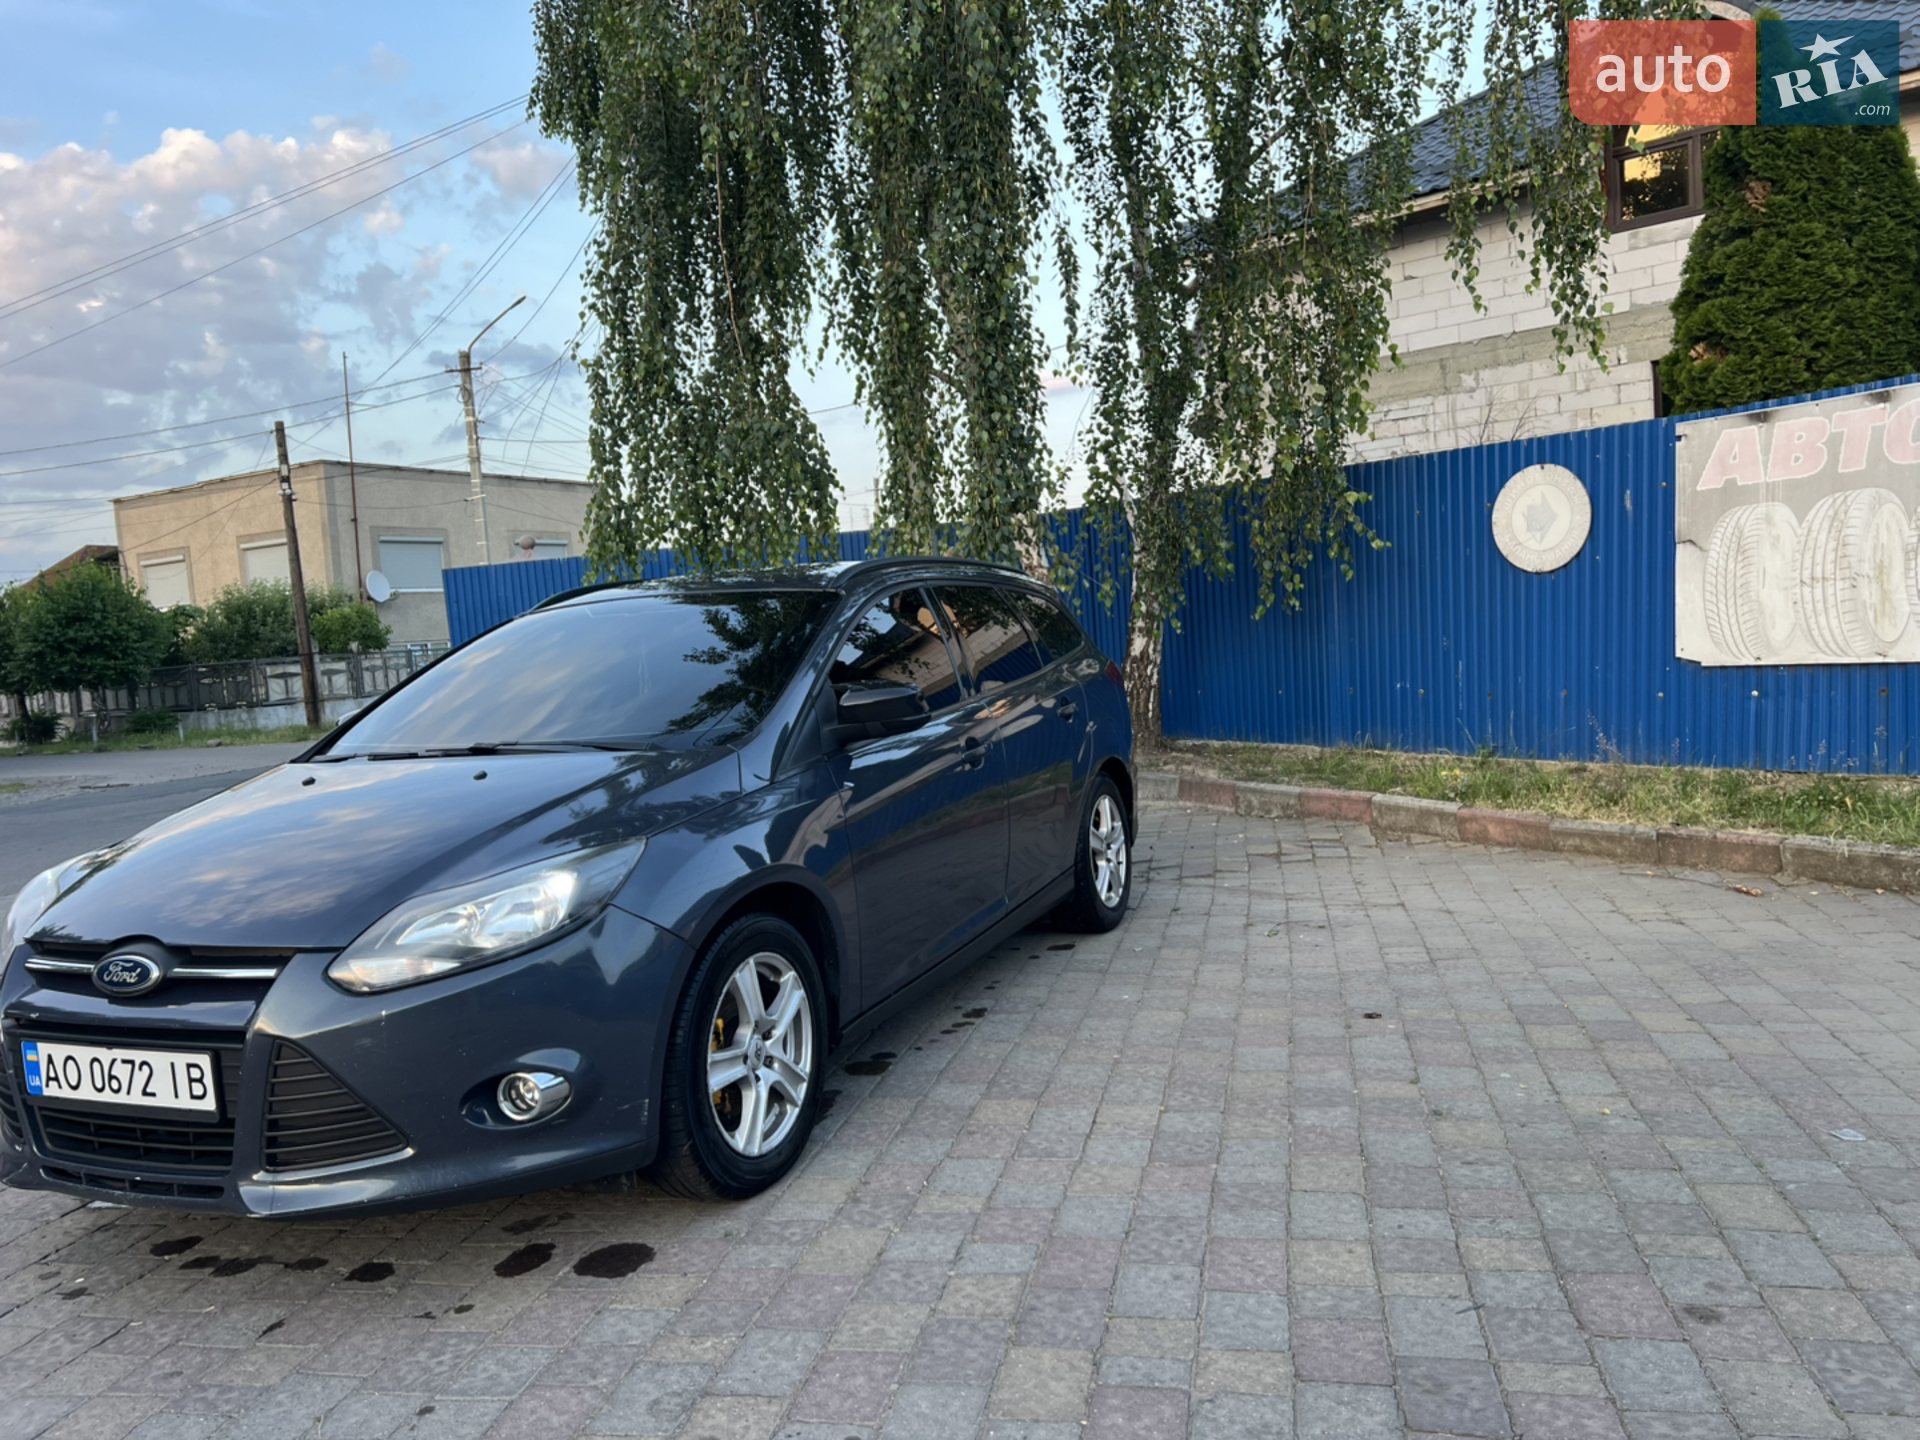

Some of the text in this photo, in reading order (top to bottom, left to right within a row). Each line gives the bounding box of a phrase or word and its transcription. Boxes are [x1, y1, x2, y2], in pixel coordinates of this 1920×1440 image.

[103, 960, 142, 983] Ford
[29, 1074, 41, 1087] UA
[45, 1053, 82, 1091] AO
[89, 1056, 157, 1098] 0672
